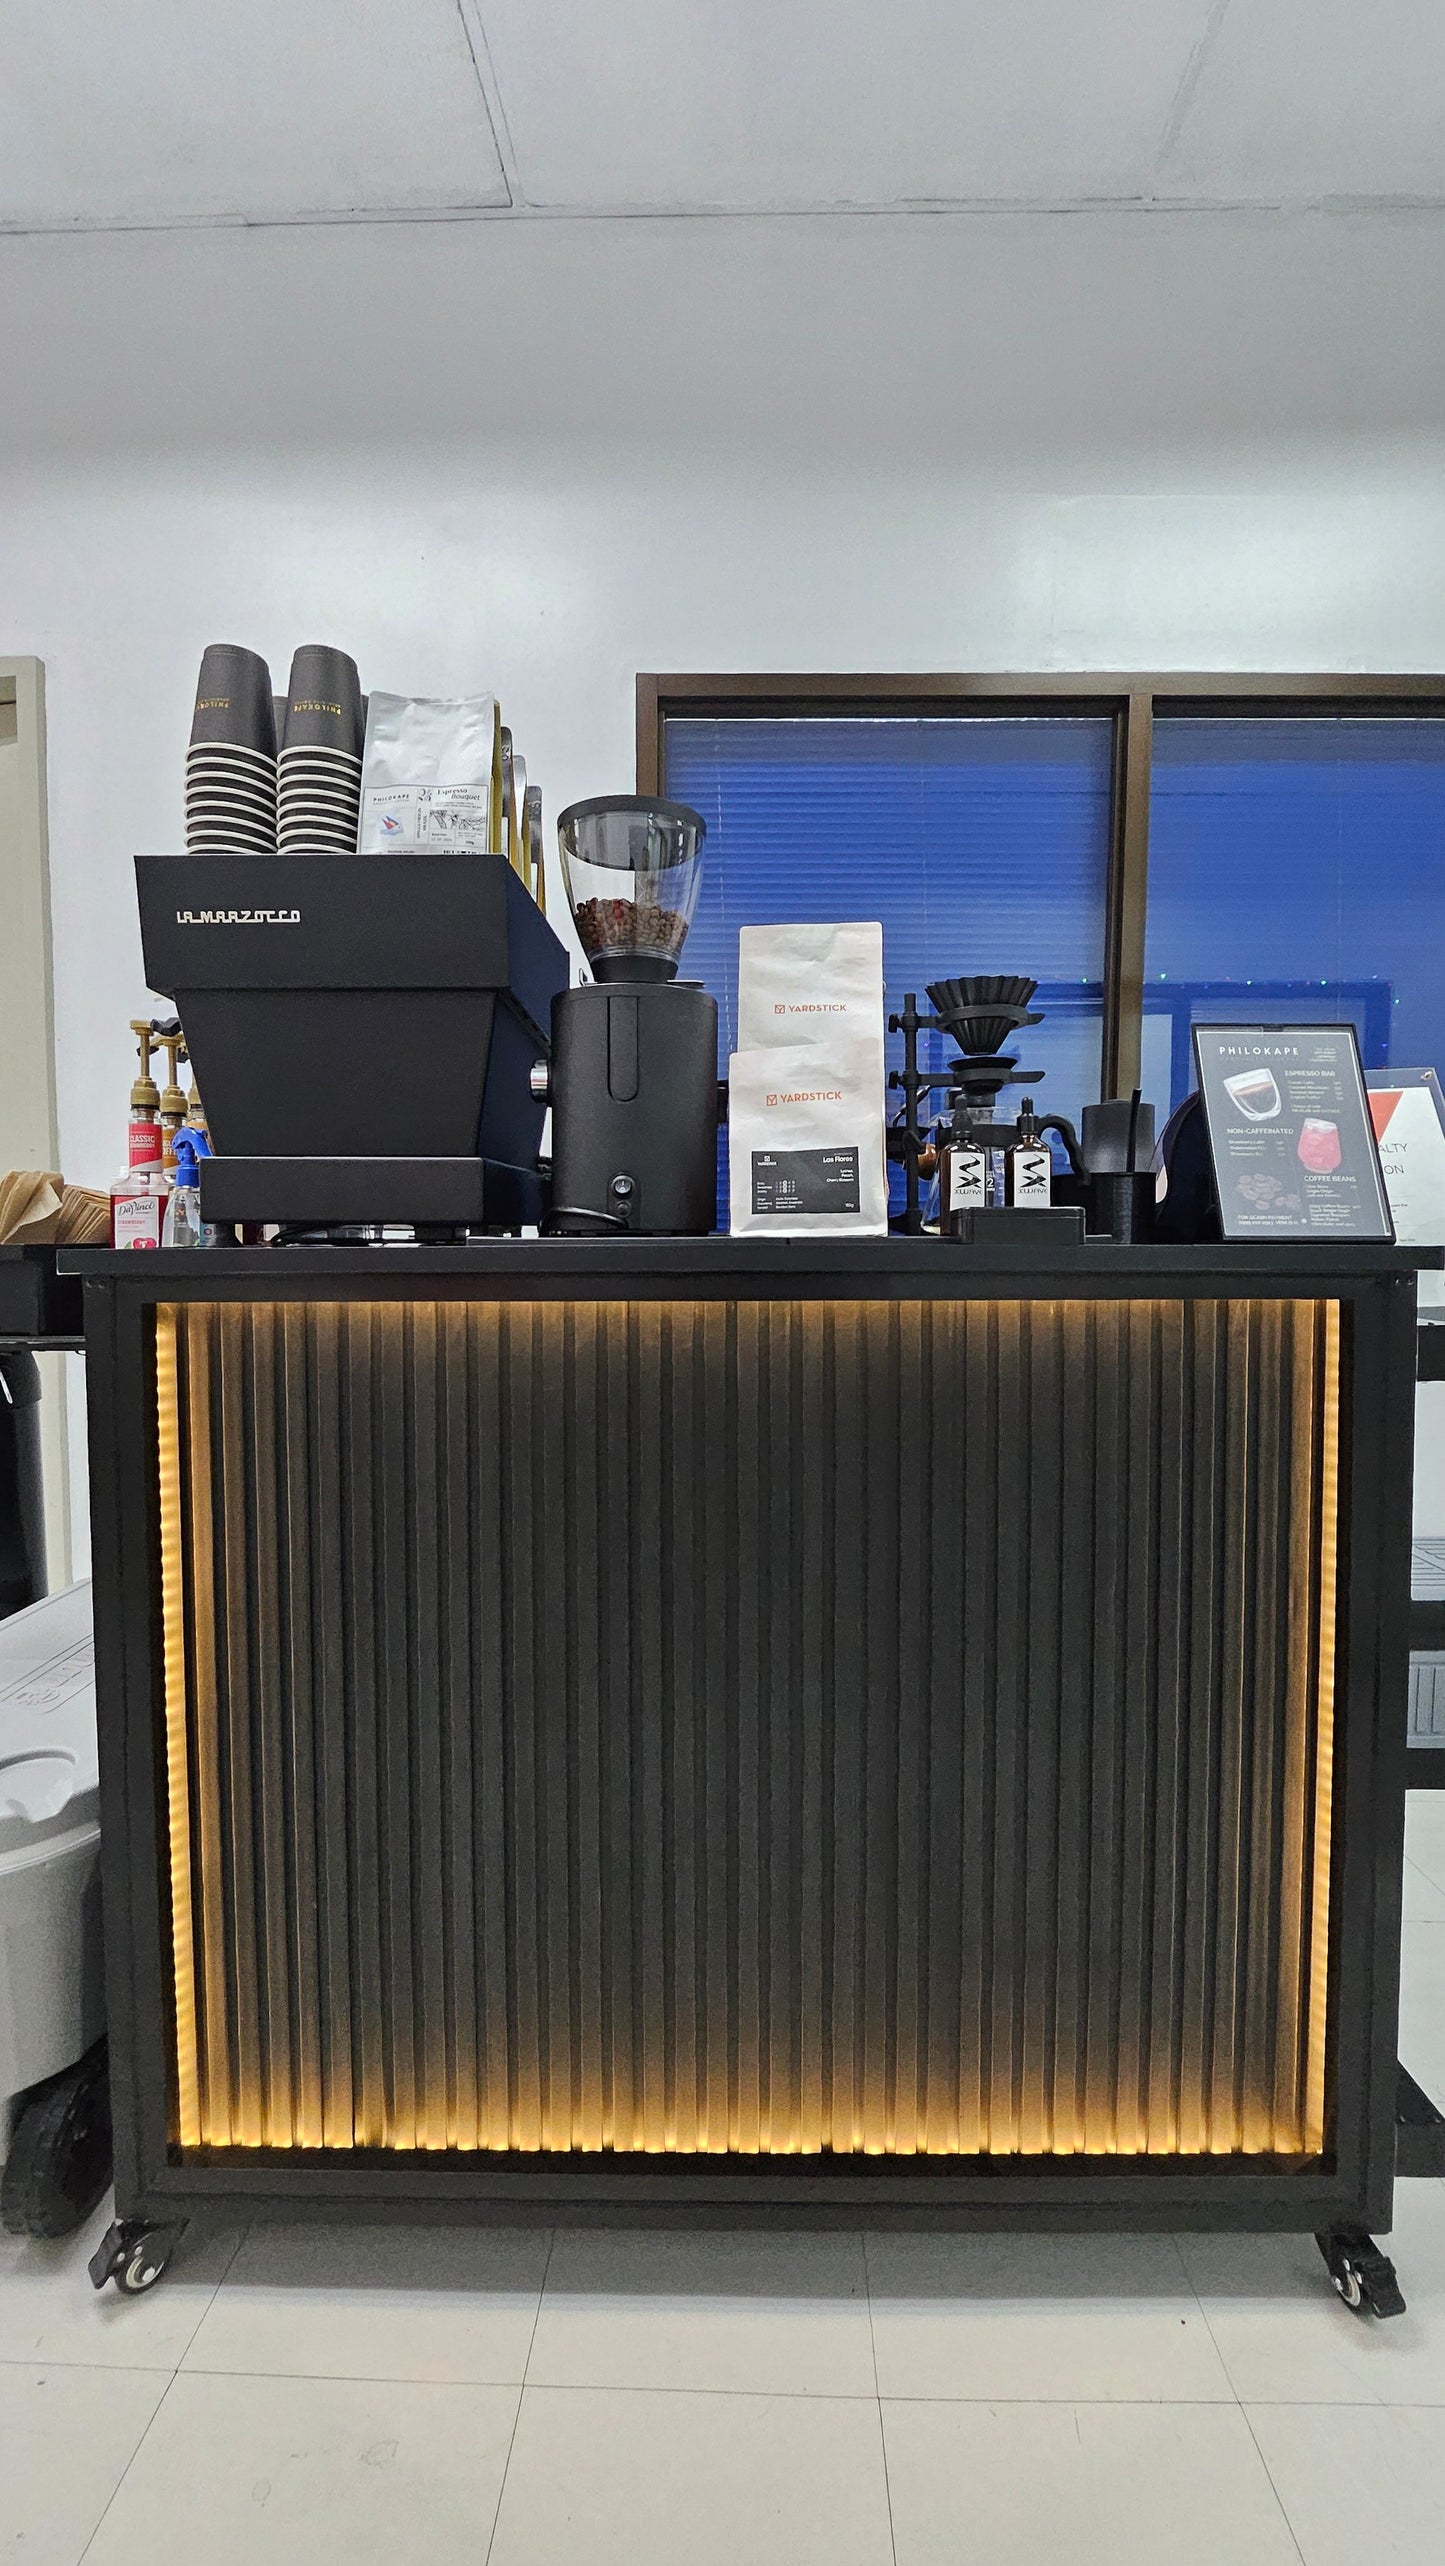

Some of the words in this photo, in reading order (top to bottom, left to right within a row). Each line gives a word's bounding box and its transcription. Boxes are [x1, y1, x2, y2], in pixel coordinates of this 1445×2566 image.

[373, 793, 410, 802] PHILOKAPE
[450, 793, 480, 801] Bouquet
[788, 1004, 847, 1012] YARDSTICK
[1219, 1046, 1300, 1056] PHILOKAPE
[780, 1091, 842, 1103] YARDSTICK
[1226, 1127, 1294, 1135] NON-CAFFEINATED
[1332, 1175, 1357, 1183] BEANS
[118, 1201, 154, 1215] DaVinci
